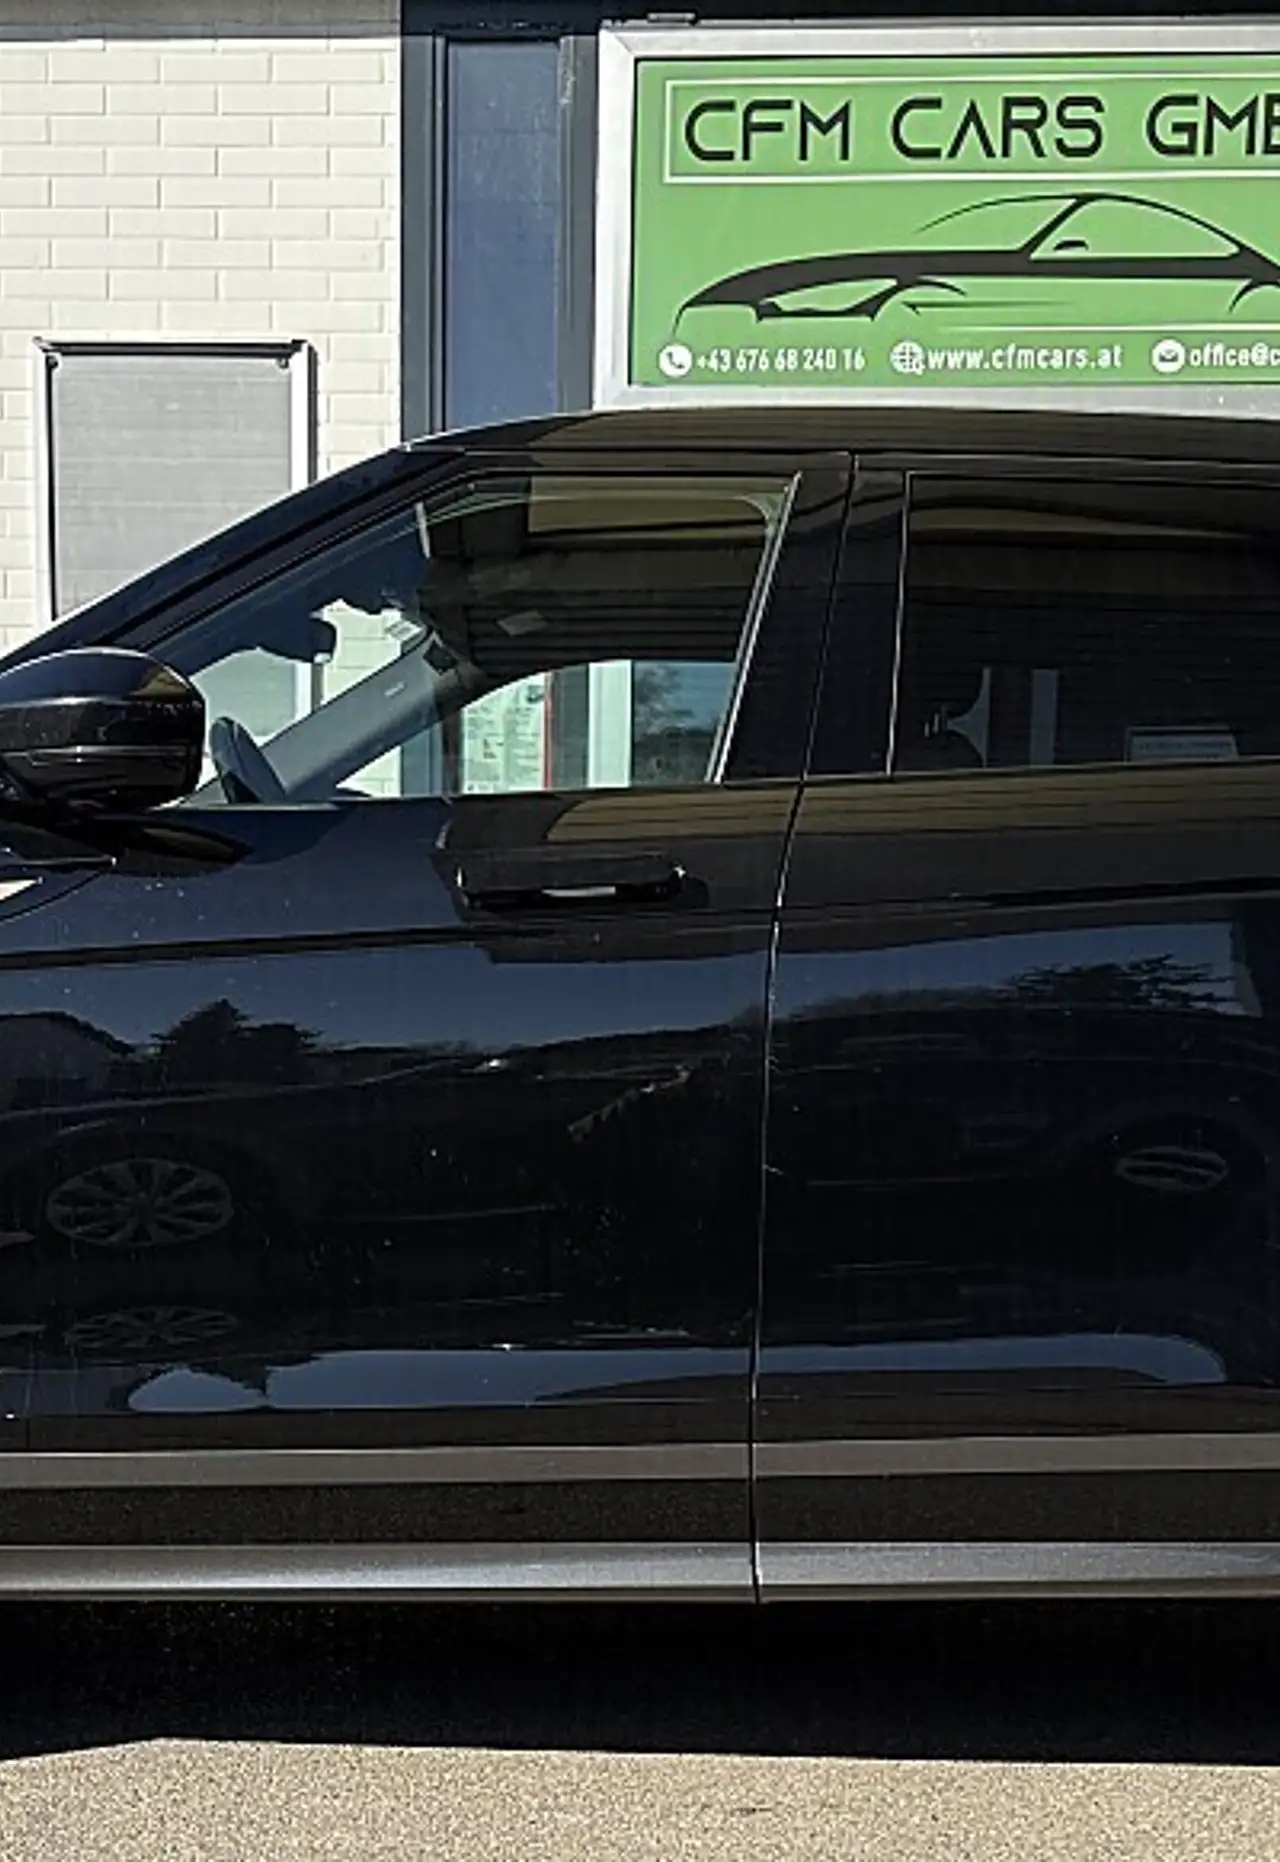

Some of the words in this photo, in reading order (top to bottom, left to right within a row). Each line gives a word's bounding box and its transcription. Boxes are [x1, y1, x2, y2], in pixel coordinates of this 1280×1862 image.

[684, 99, 851, 161] CFM
[891, 96, 1103, 159] CARS
[697, 348, 731, 372] +43
[736, 348, 769, 372] 676
[774, 348, 797, 372] 68
[803, 348, 836, 371] 240
[843, 348, 865, 371] 16
[926, 343, 1122, 370] www.cfmcars.at
